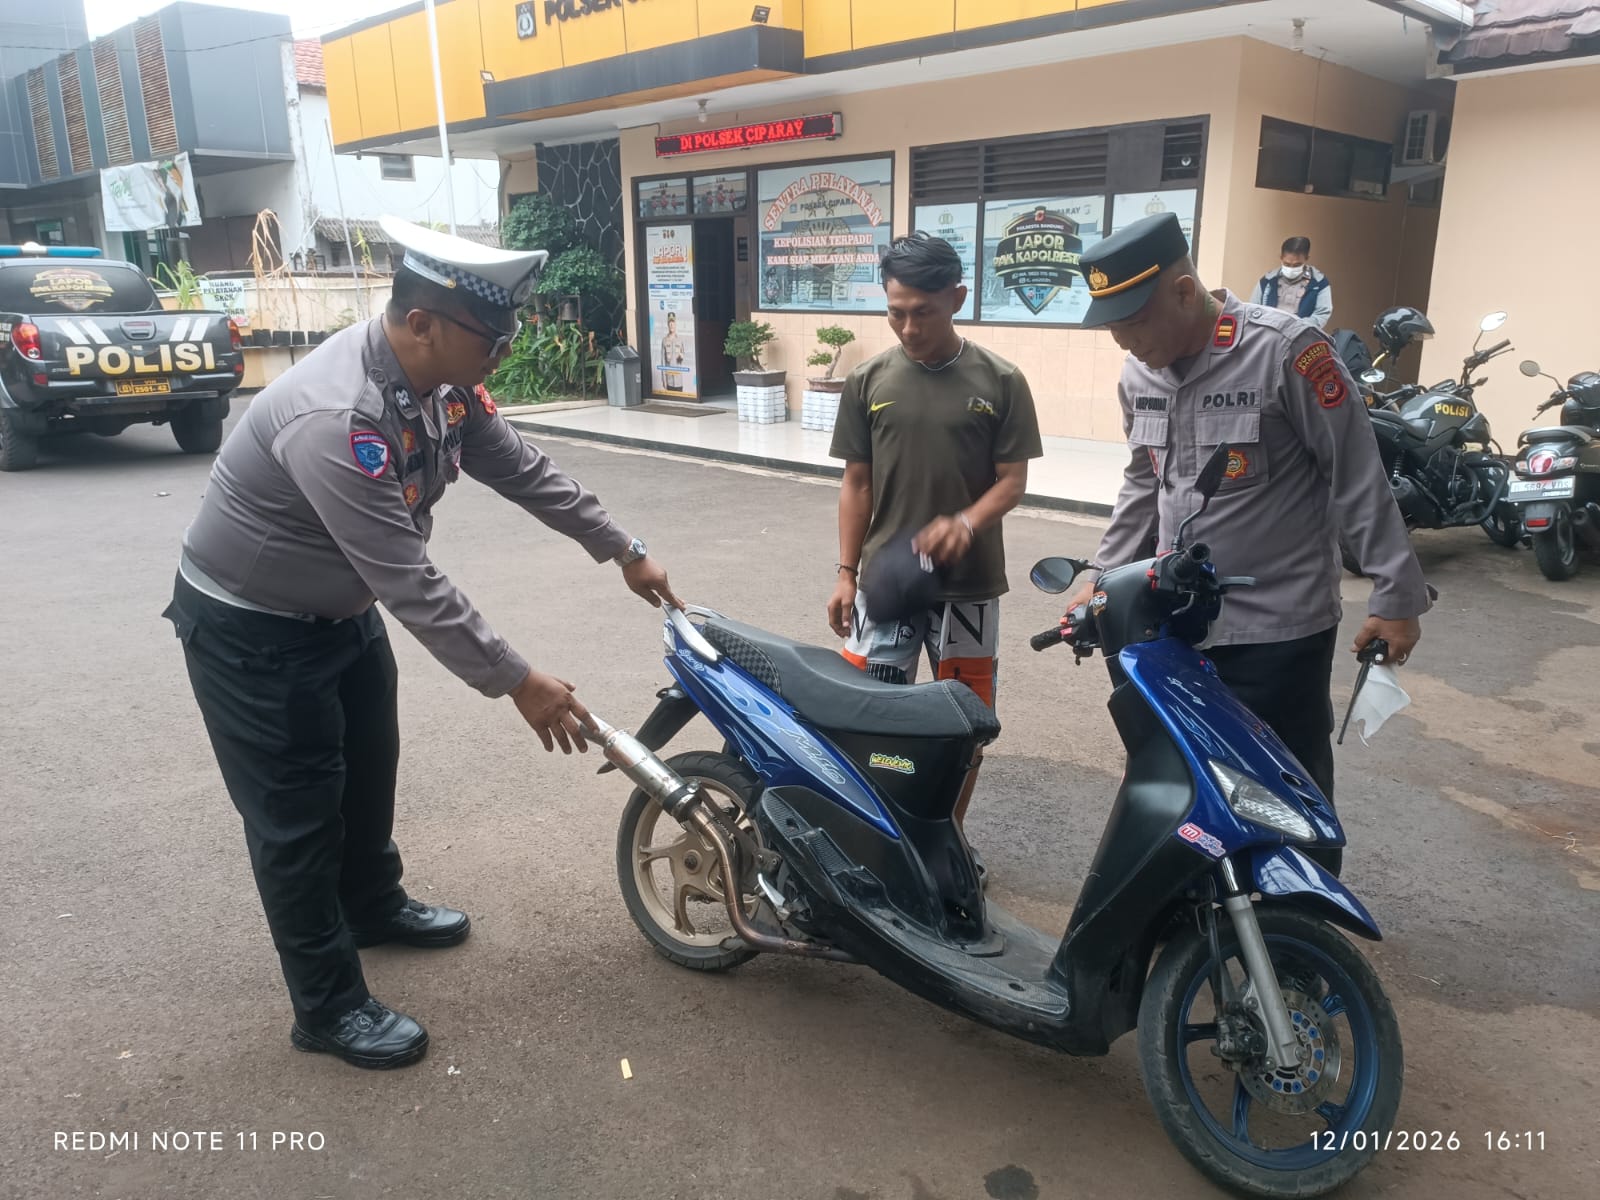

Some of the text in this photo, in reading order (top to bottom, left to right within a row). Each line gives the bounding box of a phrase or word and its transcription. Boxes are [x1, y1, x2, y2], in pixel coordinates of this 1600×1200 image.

[680, 120, 805, 150] DI POLSEK CIPARAY
[764, 172, 883, 231] SENTRA PELAYANAN
[773, 234, 873, 248] KEPOLISIAN TERPADU
[1015, 234, 1065, 251] LAPOR
[767, 253, 880, 265] KAMI SIAP MELAYANI ANDA
[1015, 250, 1080, 266] KAPOLREST
[66, 342, 215, 376] POLISI
[1202, 391, 1256, 408] POLRI
[1434, 403, 1469, 417] POLISI
